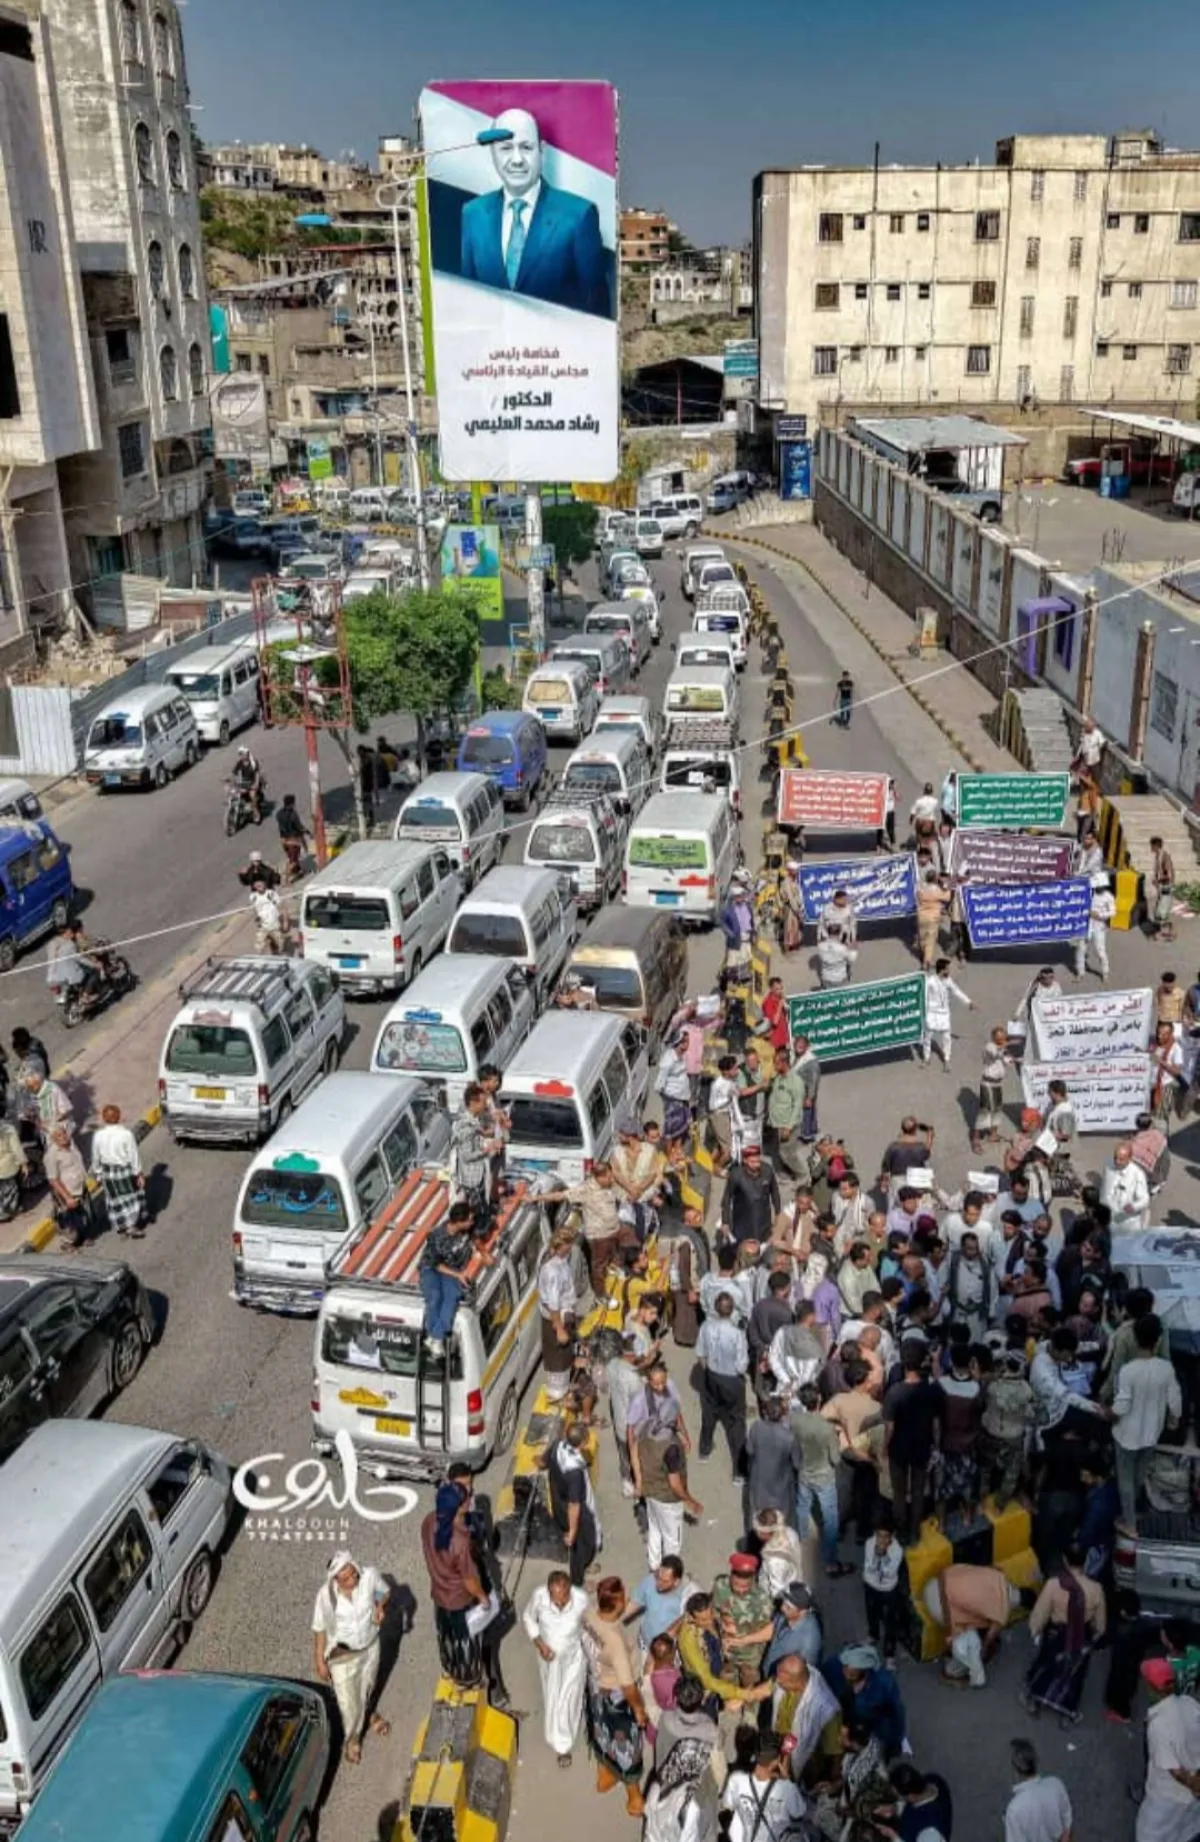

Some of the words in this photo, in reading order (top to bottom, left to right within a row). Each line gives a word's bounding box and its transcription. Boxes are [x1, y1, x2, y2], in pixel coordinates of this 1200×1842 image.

[489, 347, 520, 361] رئيس
[522, 347, 560, 359] فخامة
[461, 366, 505, 381] الرئاسي
[507, 365, 549, 377] القيادة
[551, 365, 589, 378] مجلس
[502, 391, 552, 410] الدكتور
[464, 416, 522, 436] العليمي
[524, 419, 565, 431] محمد
[567, 414, 600, 434] رشاد
[1048, 1024, 1065, 1039] تعز
[1069, 1022, 1103, 1035] محافظة
[1107, 1021, 1119, 1037] في
[1121, 1020, 1142, 1033] باص
